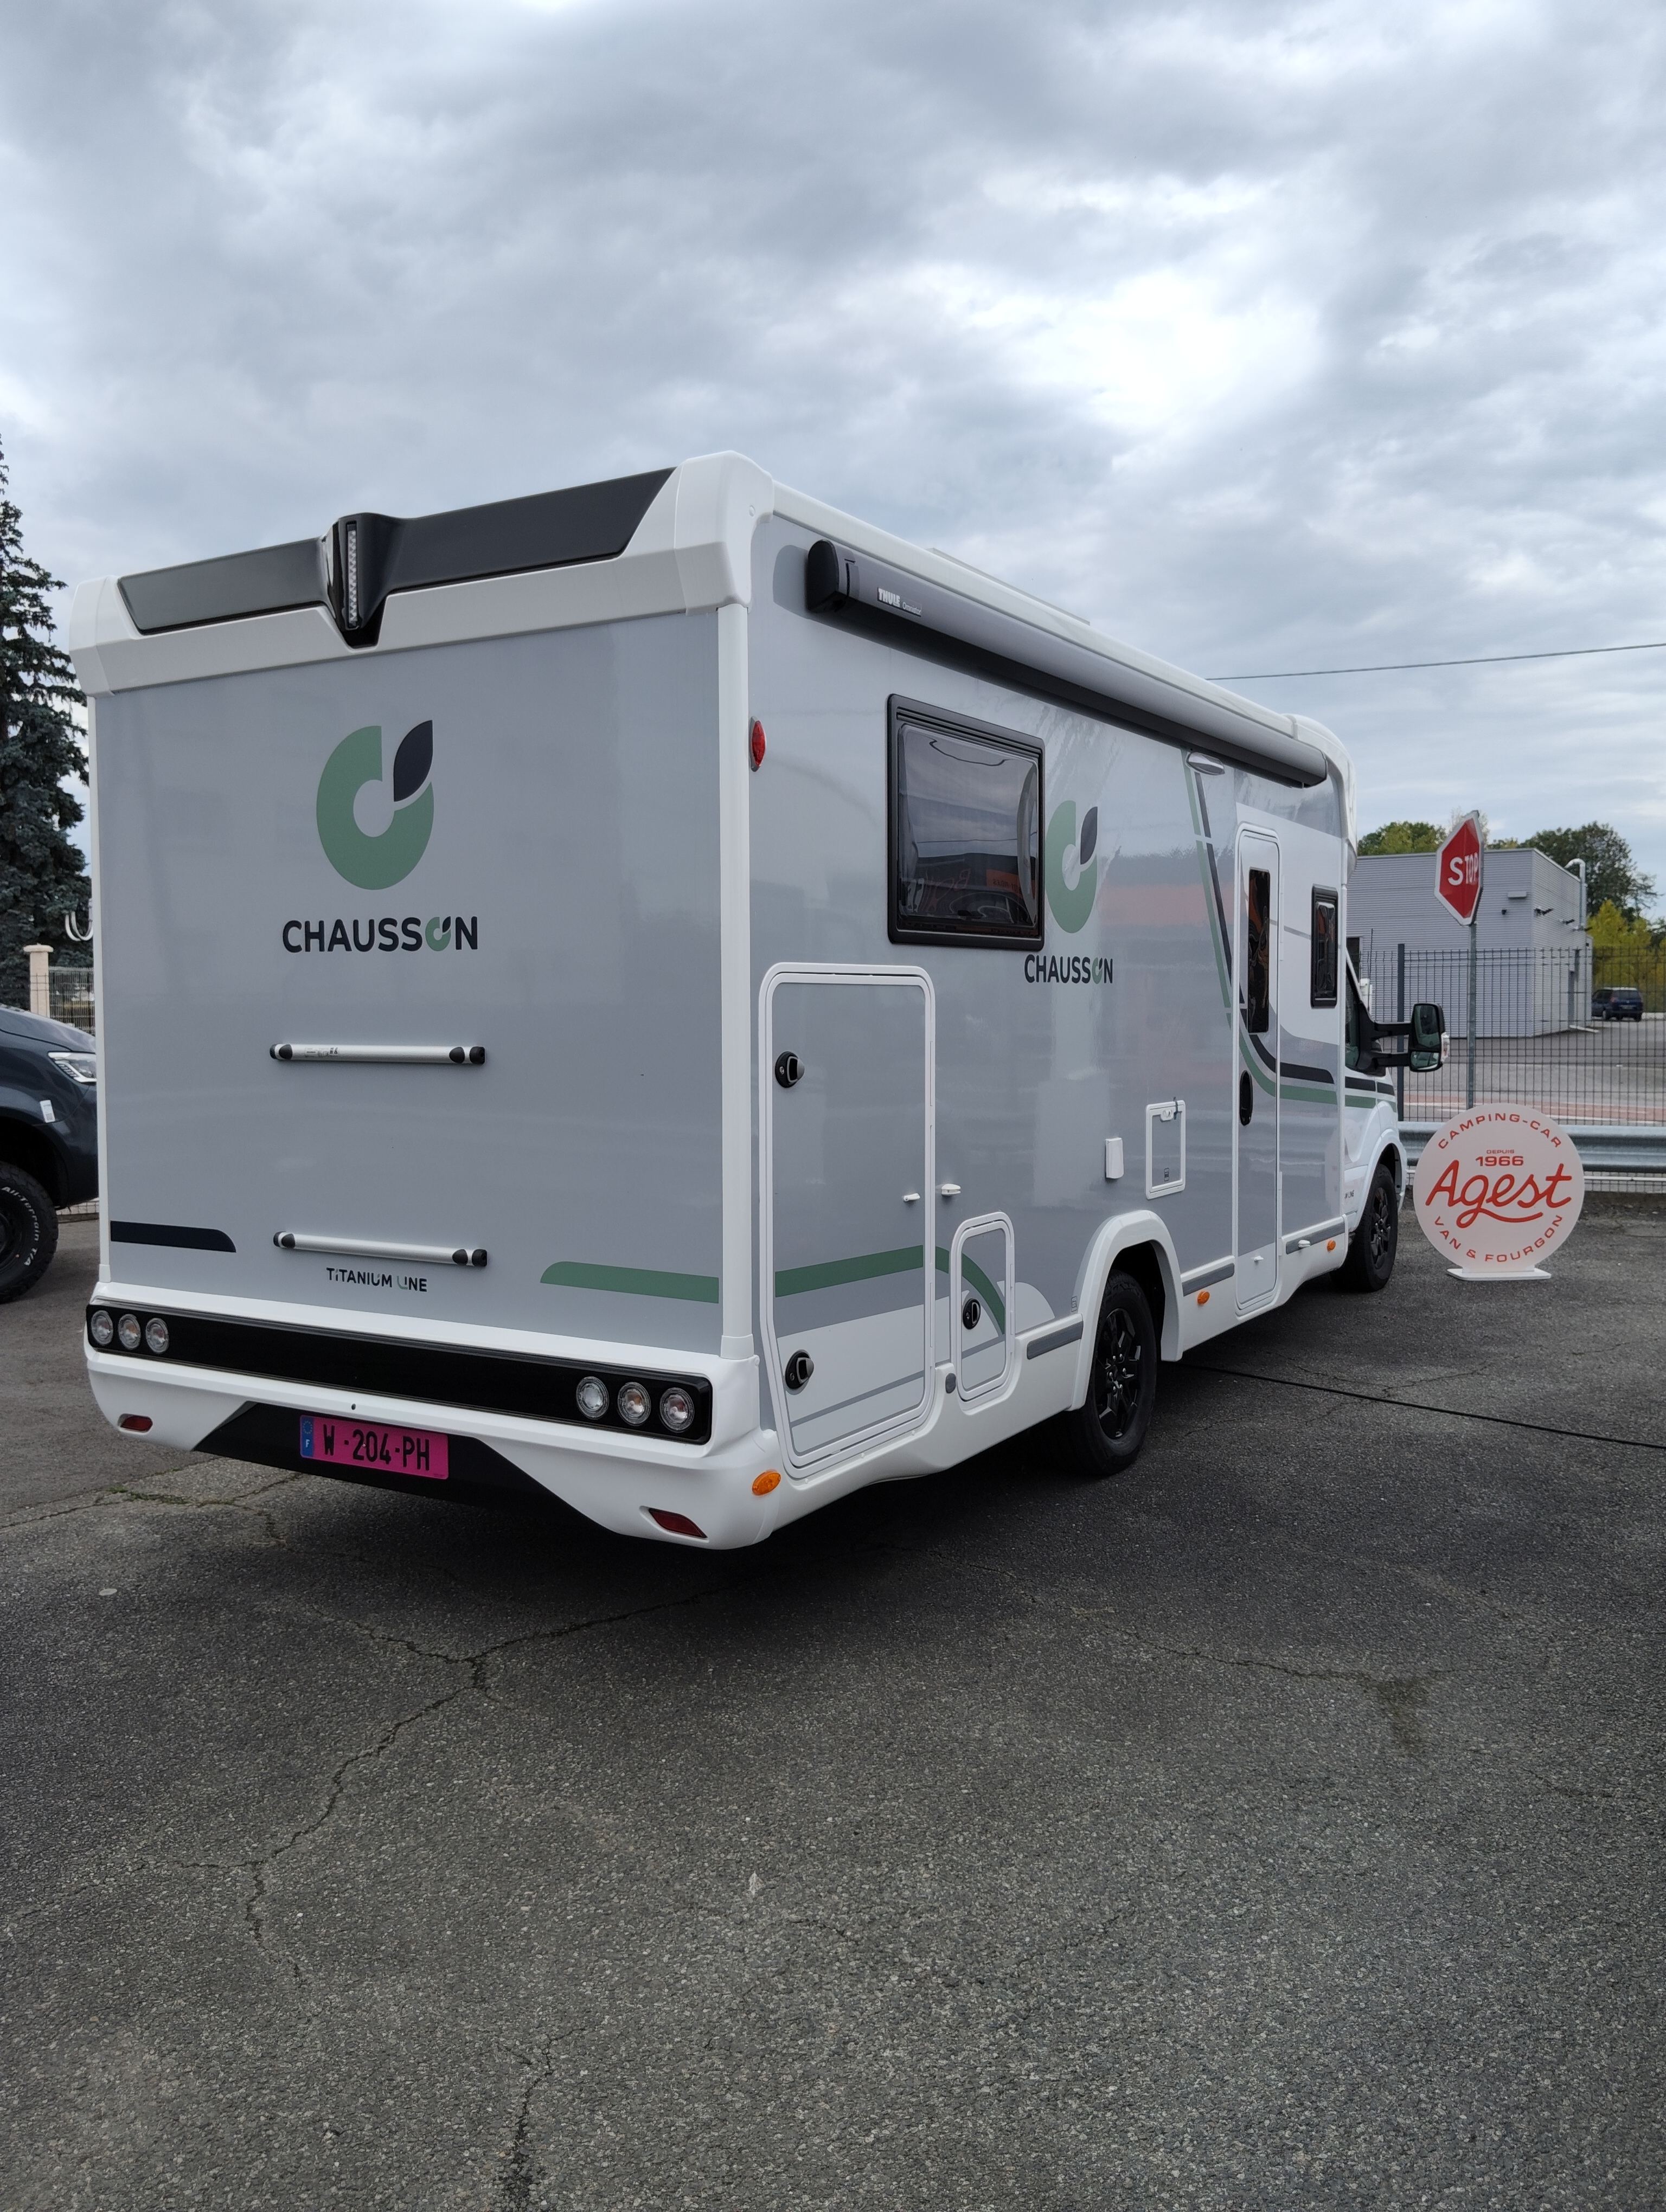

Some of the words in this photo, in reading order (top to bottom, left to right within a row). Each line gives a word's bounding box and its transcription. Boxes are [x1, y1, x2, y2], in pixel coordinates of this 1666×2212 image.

[879, 588, 900, 608] THULE
[1447, 852, 1478, 886] STOP
[282, 916, 478, 953] CHAUSSON
[1024, 954, 1113, 984] CHAUSSON
[1438, 1113, 1562, 1149] CAMPING-CAR
[1475, 1156, 1524, 1167] 1966
[1425, 1159, 1572, 1229] Agest
[1434, 1216, 1462, 1250] VAN
[1466, 1249, 1476, 1259] &
[1484, 1215, 1563, 1263] FOURGON
[396, 1275, 427, 1292] LINE
[305, 1439, 310, 1448] F
